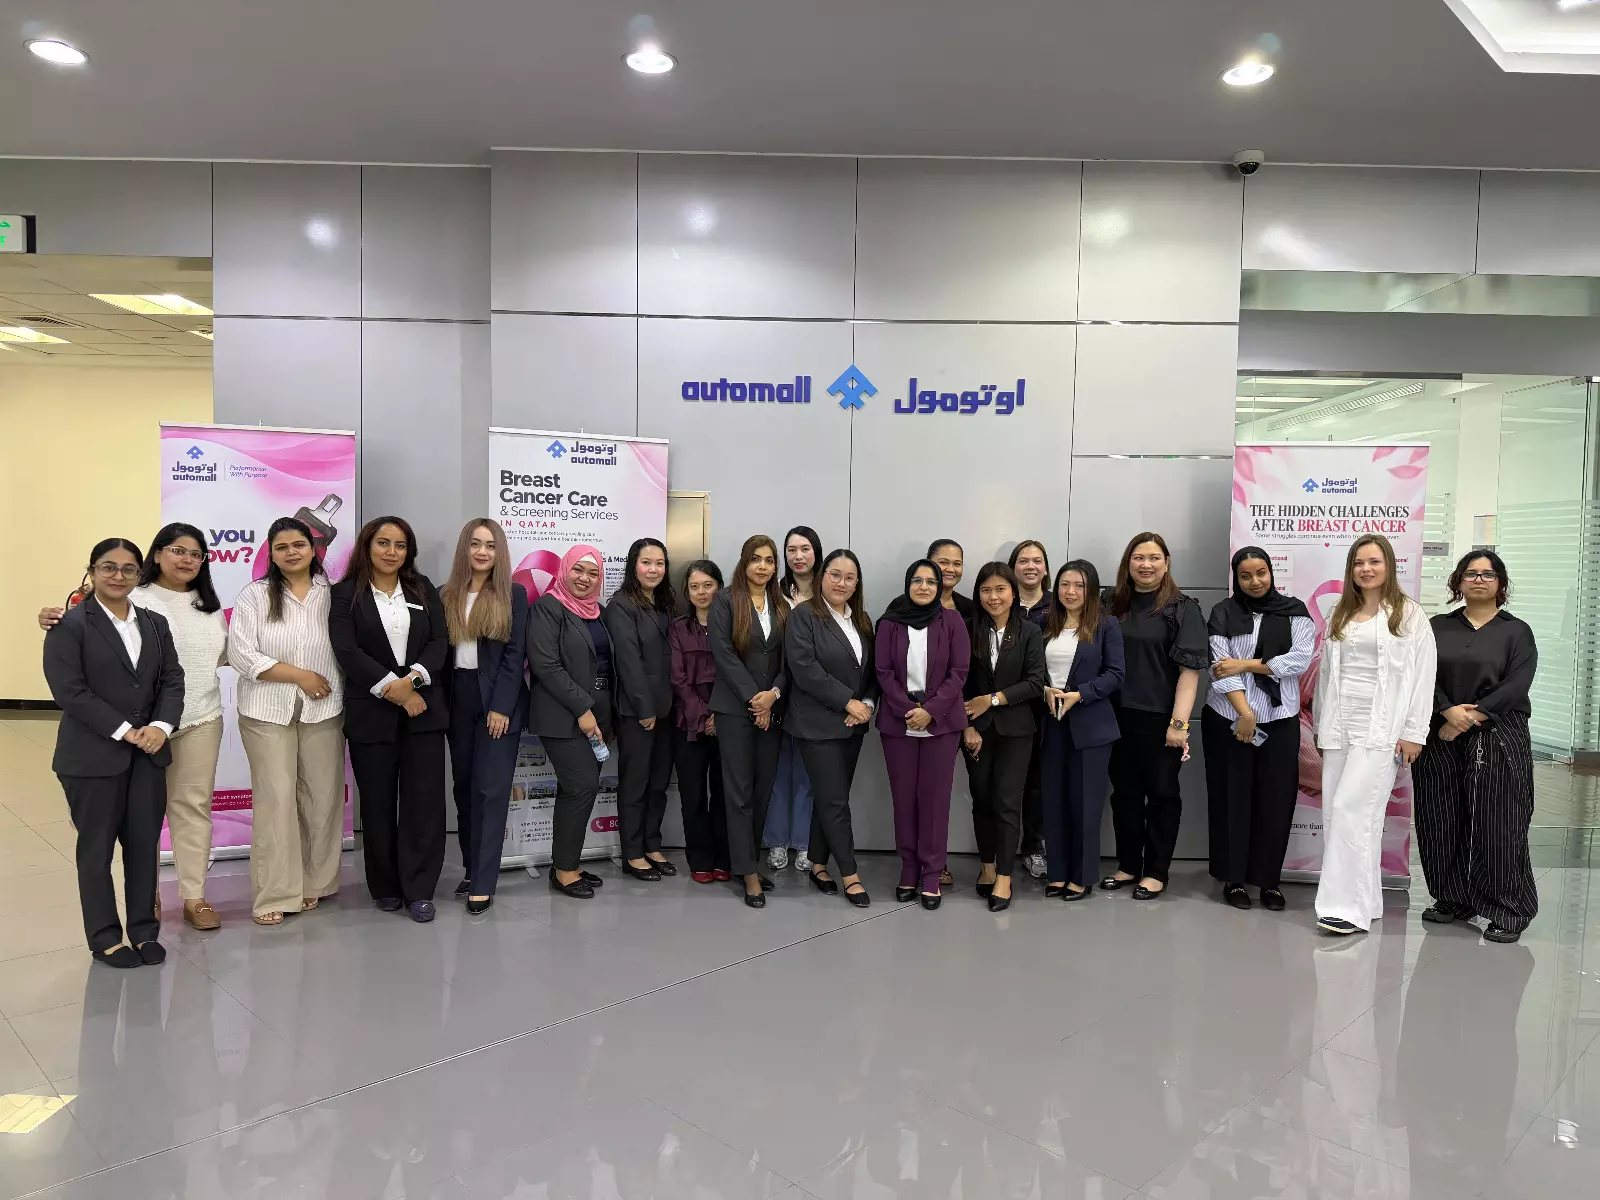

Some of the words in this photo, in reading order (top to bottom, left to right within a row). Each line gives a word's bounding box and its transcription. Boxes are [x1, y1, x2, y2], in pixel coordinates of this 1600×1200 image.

[682, 376, 811, 403] automall
[894, 377, 1026, 415] اوتومول
[571, 456, 617, 466] automall
[173, 473, 217, 482] automall
[500, 470, 561, 488] Breast
[500, 488, 563, 505] Cancer
[567, 491, 608, 507] Care
[1322, 486, 1358, 494] automall
[500, 506, 509, 516] &
[511, 506, 568, 520] Screening
[570, 509, 619, 521] Services
[1250, 505, 1275, 517] THE
[1278, 505, 1326, 518] HIDDEN
[1329, 505, 1410, 518] CHALLENGES
[518, 520, 556, 528] QATAR
[1251, 518, 1295, 532] AFTER
[1297, 519, 1350, 532] BREAST
[1351, 519, 1407, 533] CANCER
[209, 529, 255, 546] you
[208, 547, 254, 564] ow?
[1309, 822, 1324, 830] than
